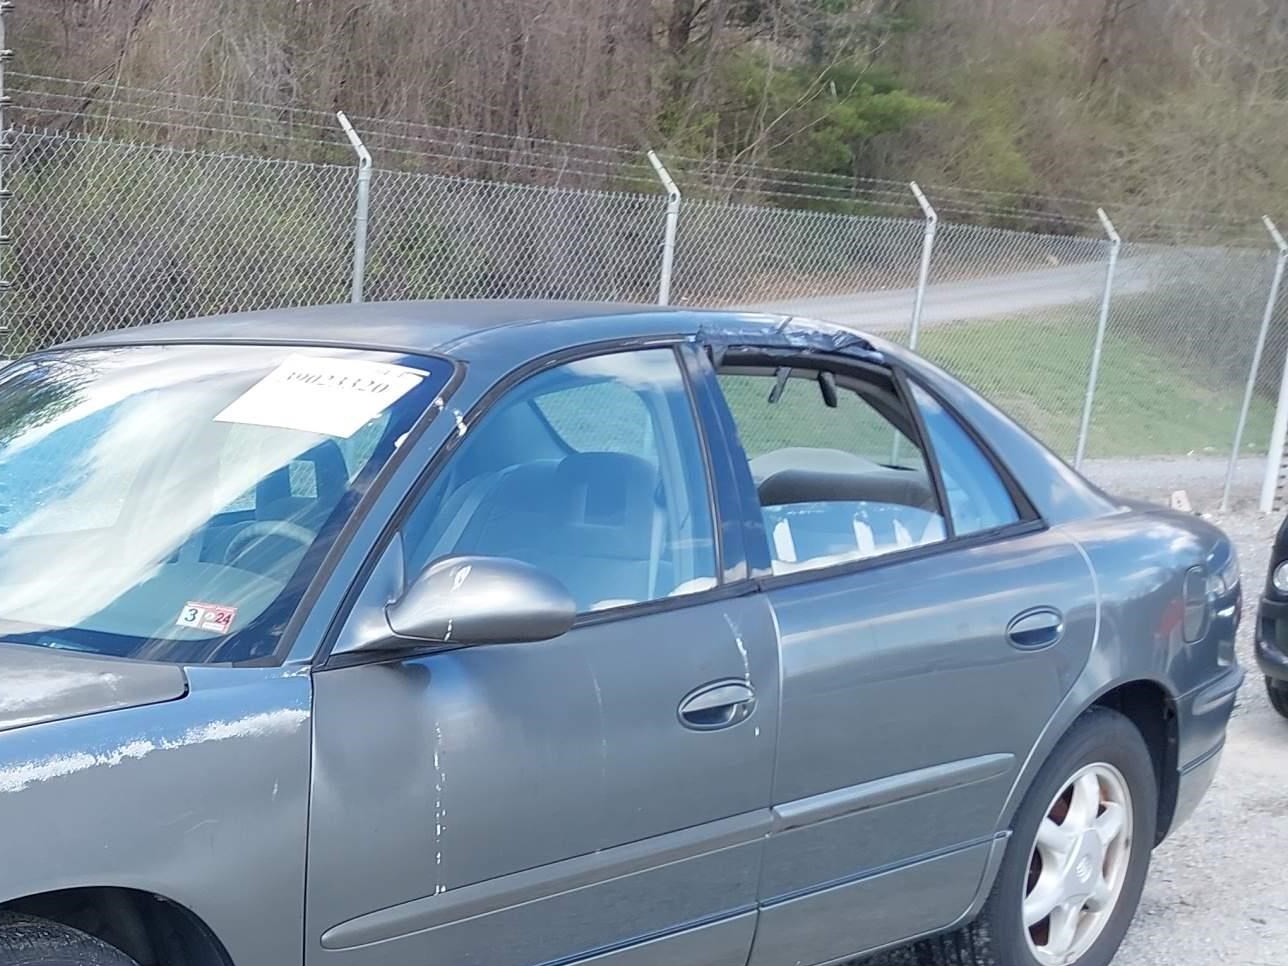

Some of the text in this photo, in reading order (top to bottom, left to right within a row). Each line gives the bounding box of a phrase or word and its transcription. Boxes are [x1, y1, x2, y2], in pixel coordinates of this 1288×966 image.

[286, 371, 391, 393] 39023320
[184, 608, 232, 625] 3 24
